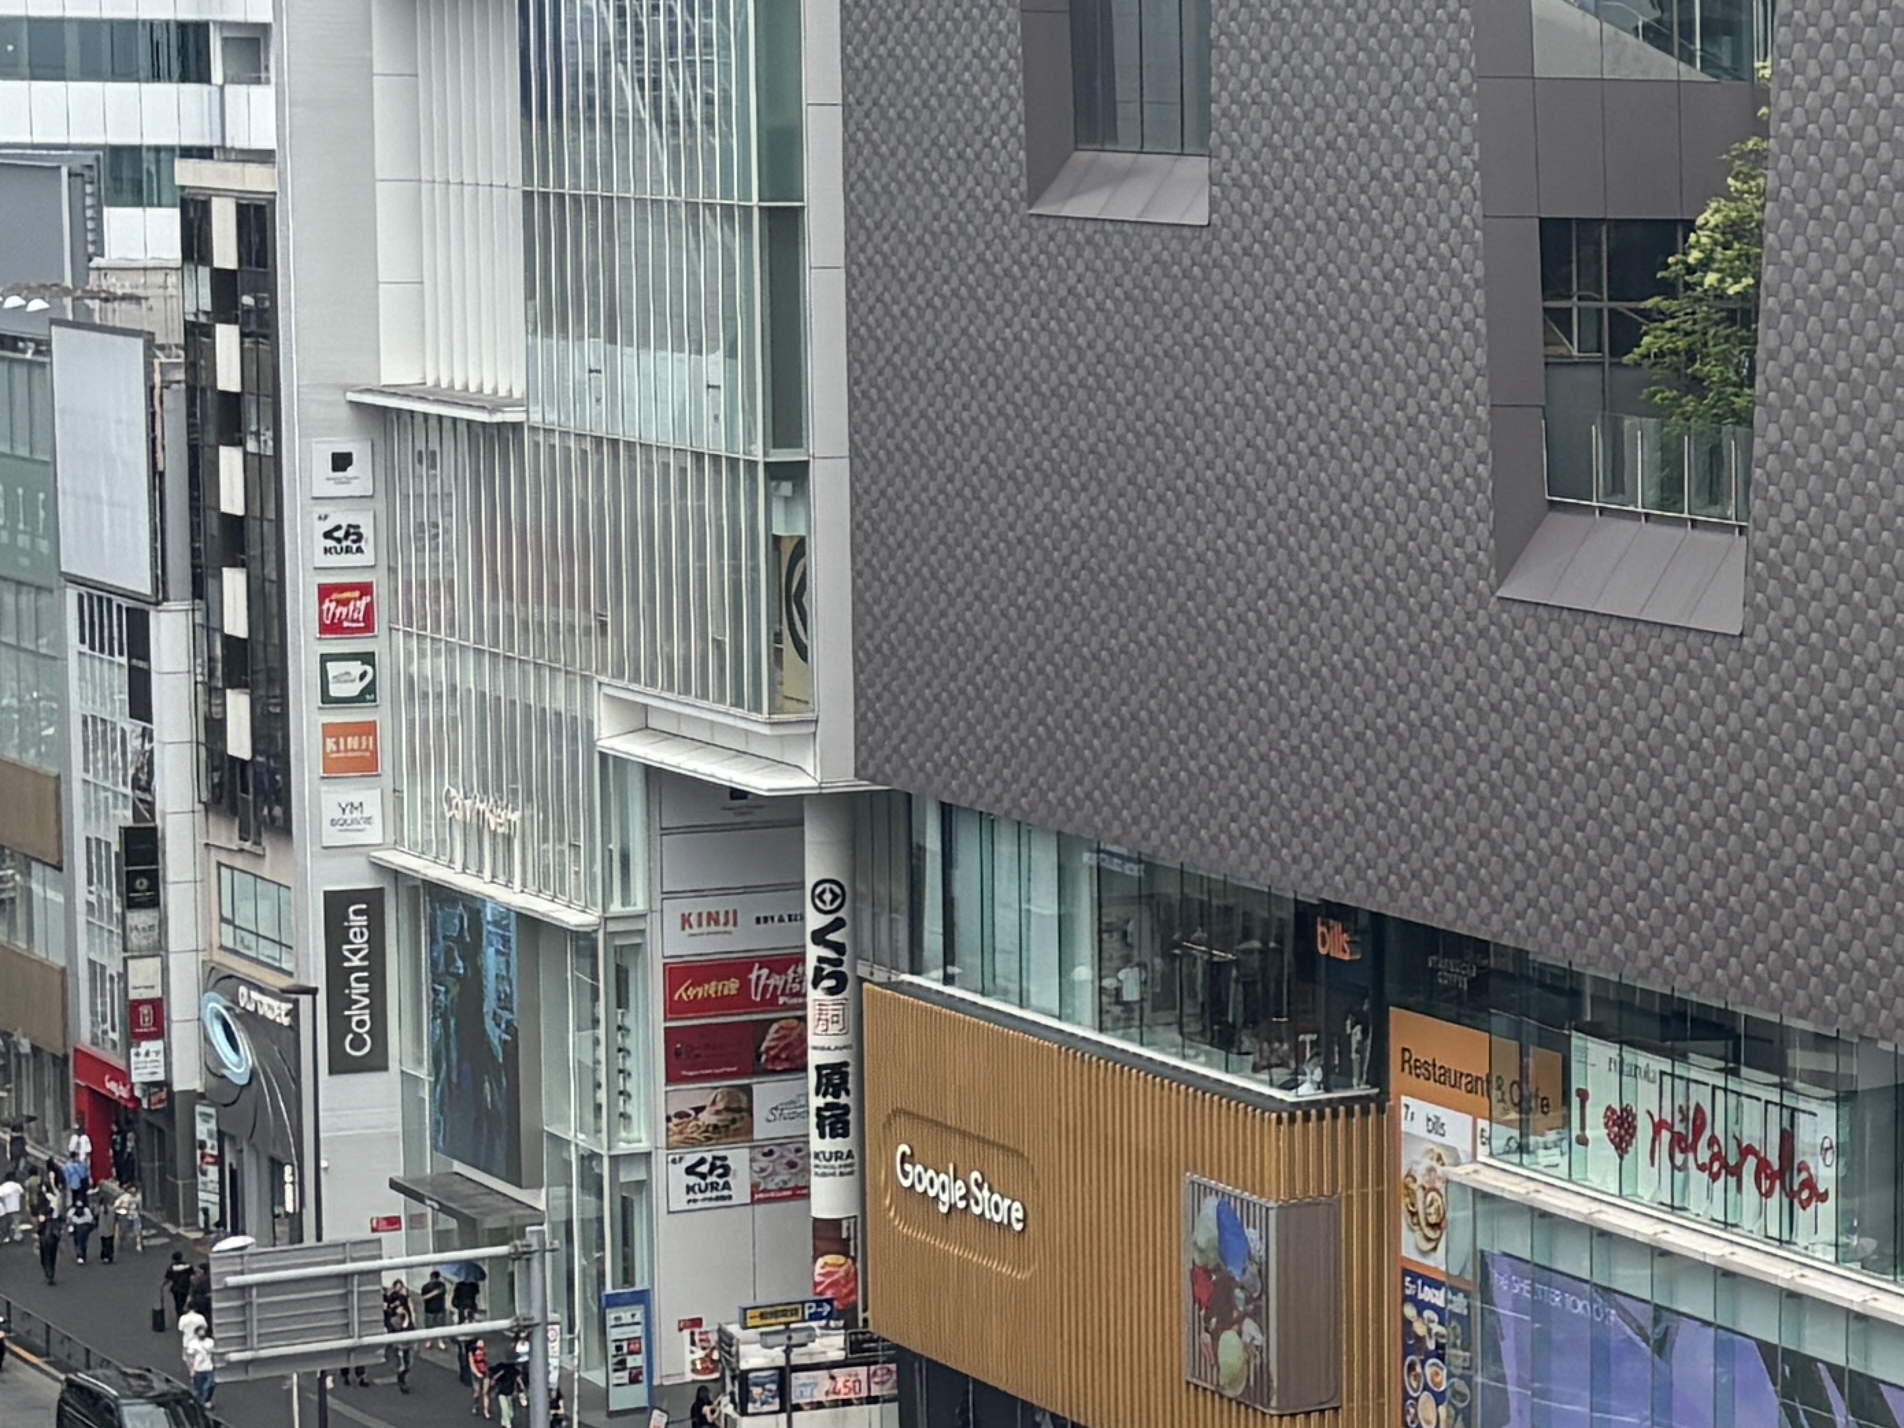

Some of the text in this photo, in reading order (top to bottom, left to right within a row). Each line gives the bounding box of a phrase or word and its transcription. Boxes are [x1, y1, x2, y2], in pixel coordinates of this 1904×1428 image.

[324, 544, 364, 555] KURA
[338, 801, 364, 815] YM
[681, 908, 739, 932] KINJI
[1316, 916, 1361, 961] bills
[810, 916, 849, 997] くら
[342, 903, 373, 1058] Calvin Klein
[814, 1060, 851, 1140] 原宿
[1510, 1080, 1550, 1115] Cfe
[1426, 1113, 1446, 1137] bills
[685, 1156, 732, 1180] くら
[814, 1150, 855, 1162] KURA
[685, 1180, 733, 1195] KURA
[896, 1143, 1025, 1231] Google Store
[804, 1303, 817, 1320] P
